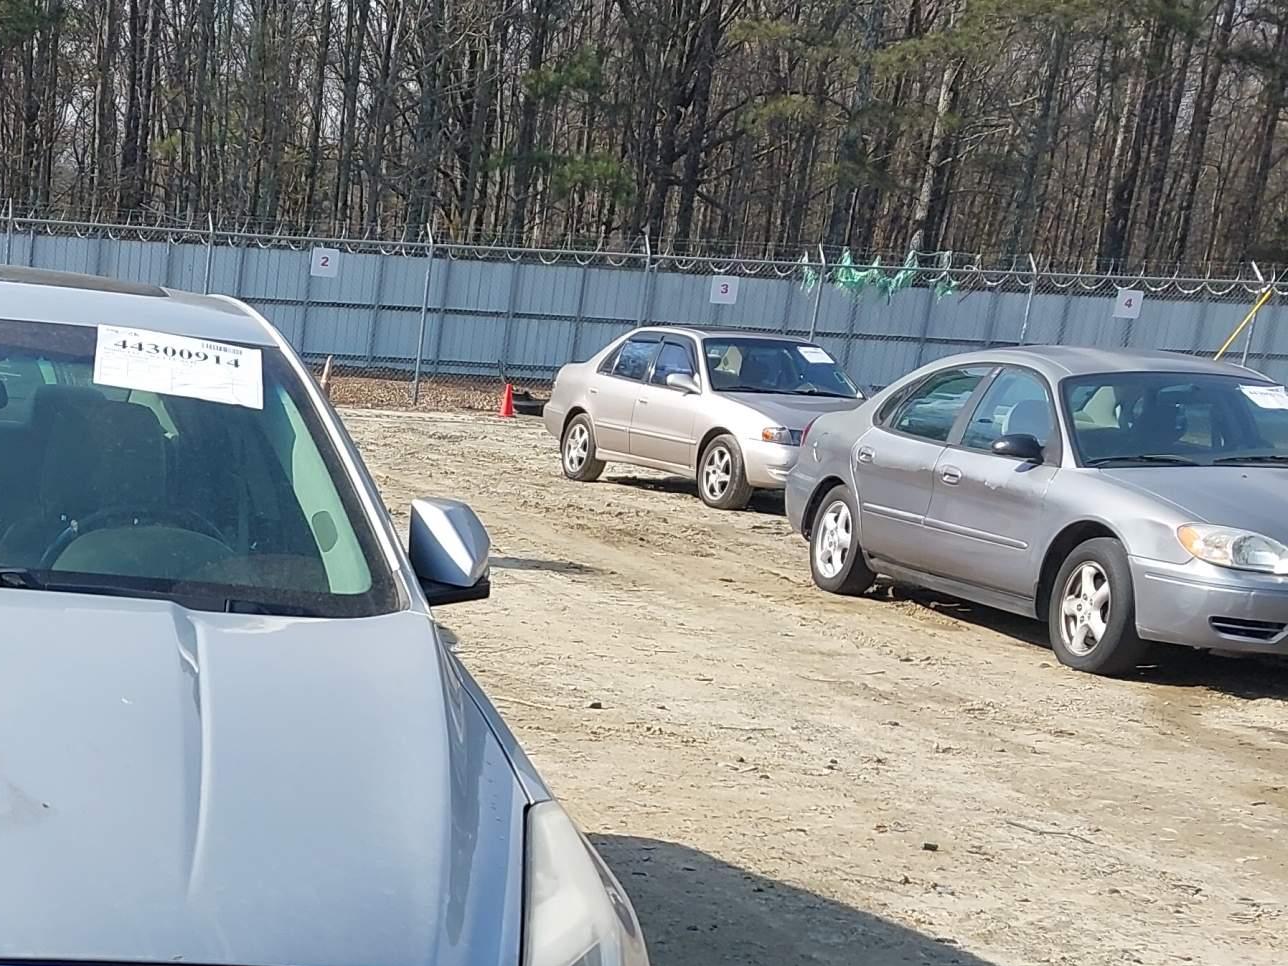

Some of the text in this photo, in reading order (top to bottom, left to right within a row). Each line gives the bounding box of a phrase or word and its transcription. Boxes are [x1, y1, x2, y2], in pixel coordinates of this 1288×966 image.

[321, 256, 329, 267] 2
[720, 283, 729, 294] 3
[1124, 298, 1133, 309] 4
[113, 339, 241, 369] 44300914
